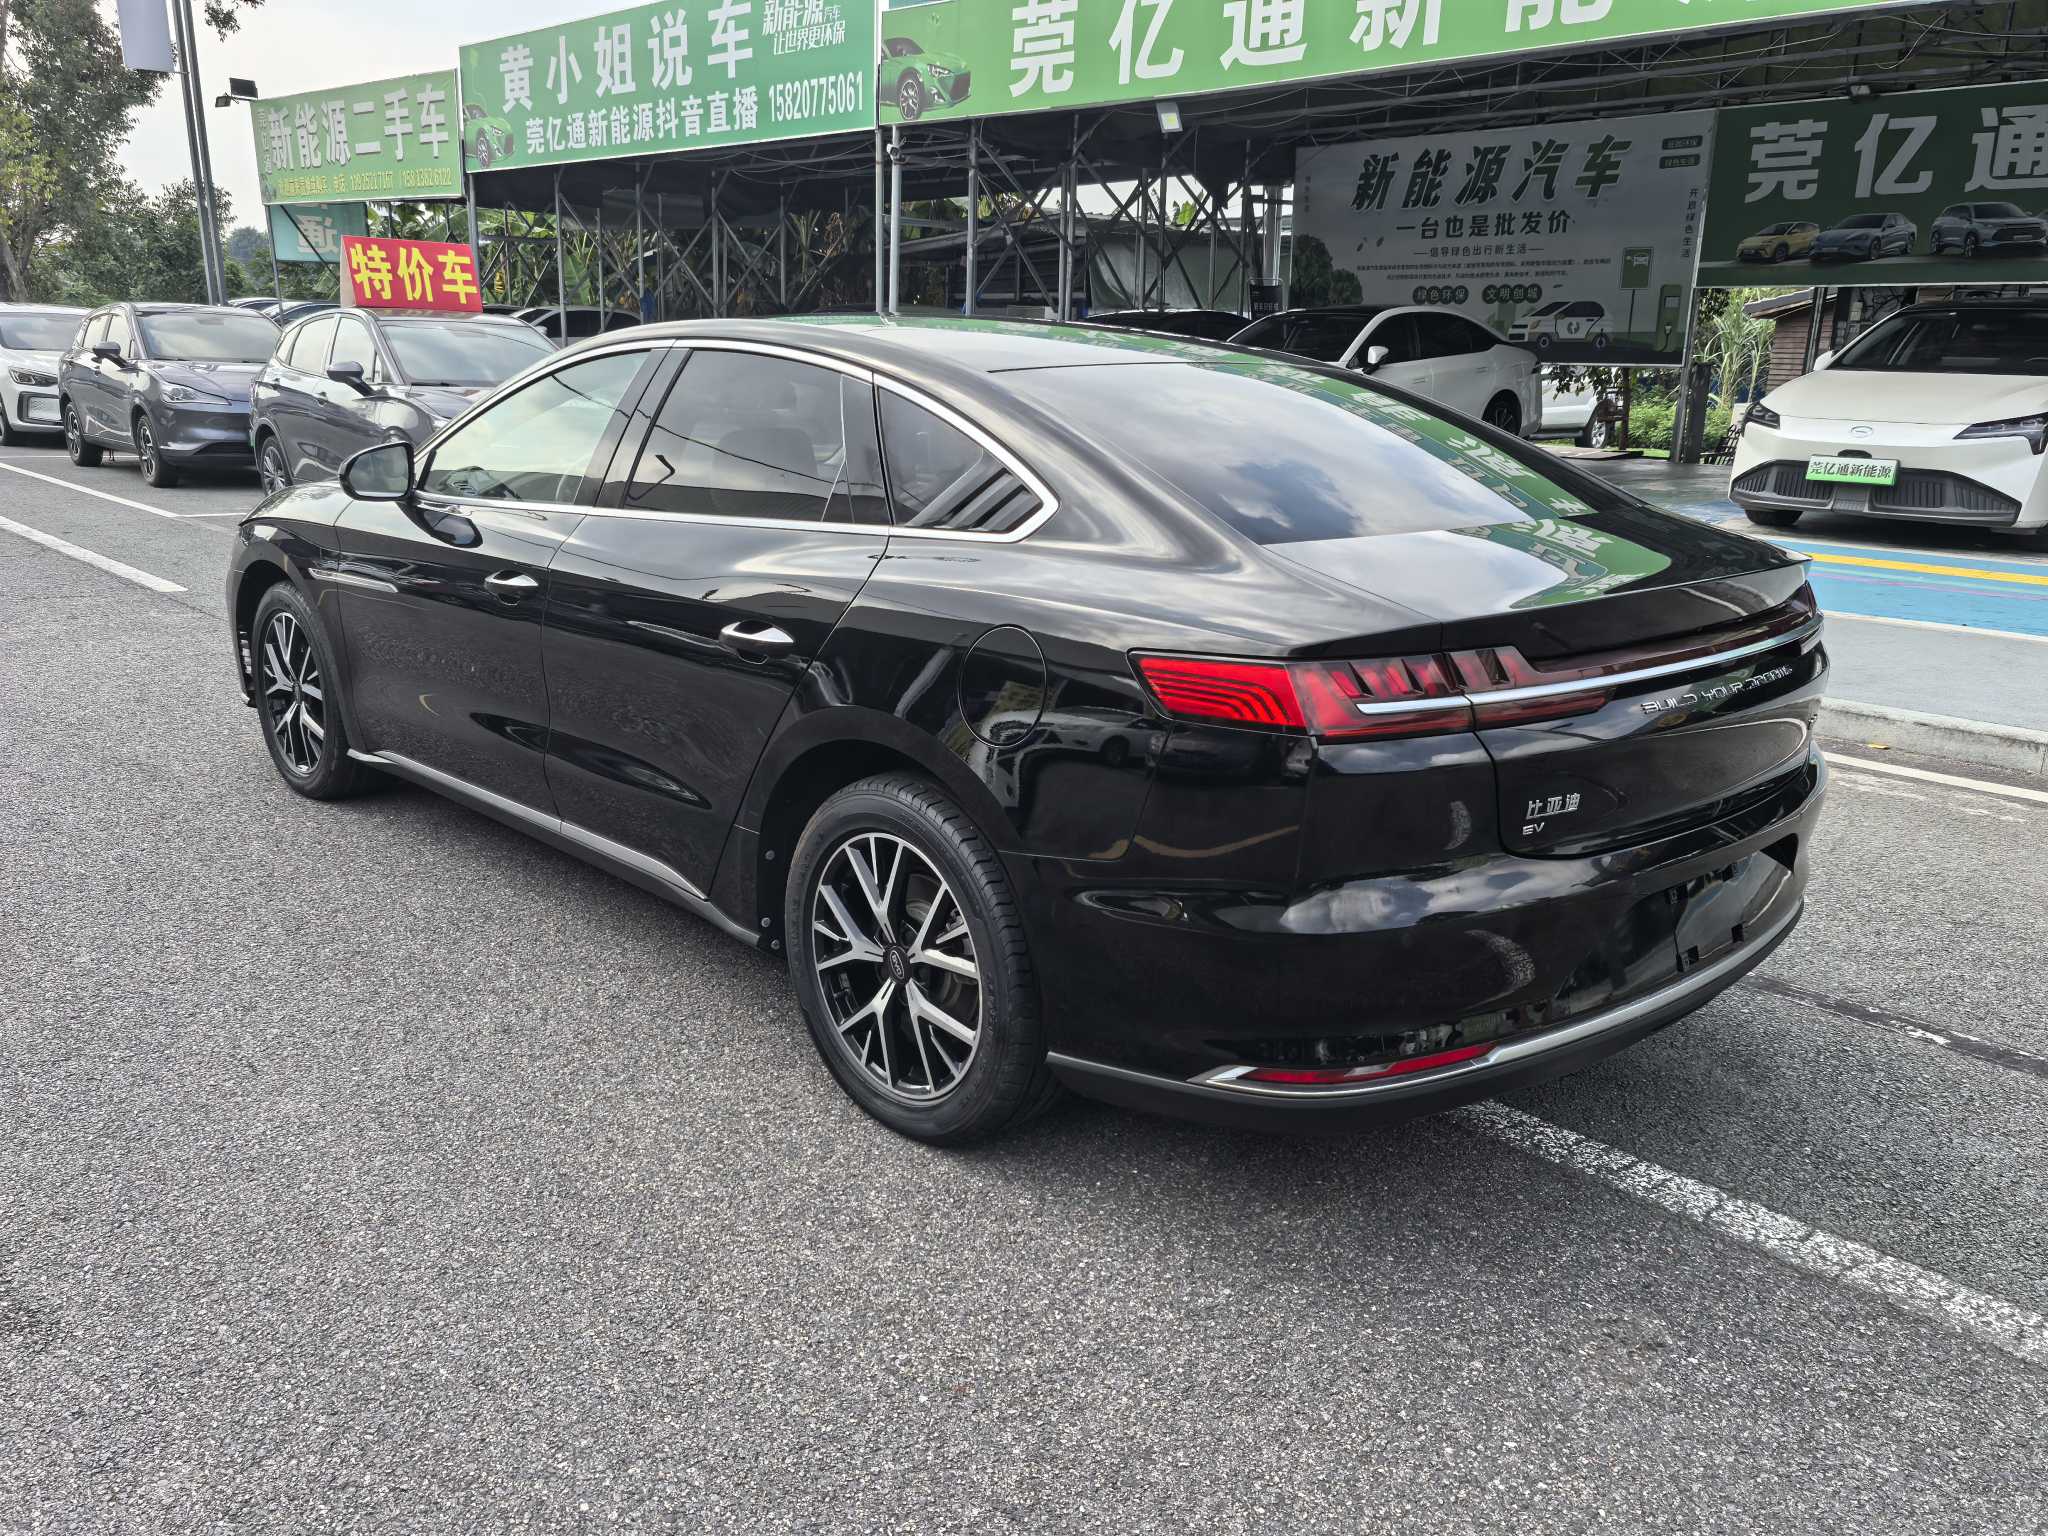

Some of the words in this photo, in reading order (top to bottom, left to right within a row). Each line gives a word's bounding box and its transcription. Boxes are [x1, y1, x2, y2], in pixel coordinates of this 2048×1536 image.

[500, 0, 753, 113] 黄小姐说车
[774, 20, 846, 55] 让世界更环保
[269, 83, 449, 171] 新能源二手车
[526, 85, 759, 155] 莞亿通新能源抖音直播
[769, 71, 863, 122] 15820775061
[1350, 134, 1632, 211] 新能源汽车
[1744, 103, 2048, 204] 莞亿通
[1396, 209, 1571, 240] 一台也是批发价
[350, 243, 478, 305] 特价车
[1809, 460, 1892, 479] 莞亿通新能源
[1640, 693, 1698, 714] BUILD
[1701, 681, 1744, 702] YOUR
[1745, 664, 1793, 689] DREAMS
[1522, 821, 1545, 836] EV
[1526, 792, 1581, 820] 比亚迪
